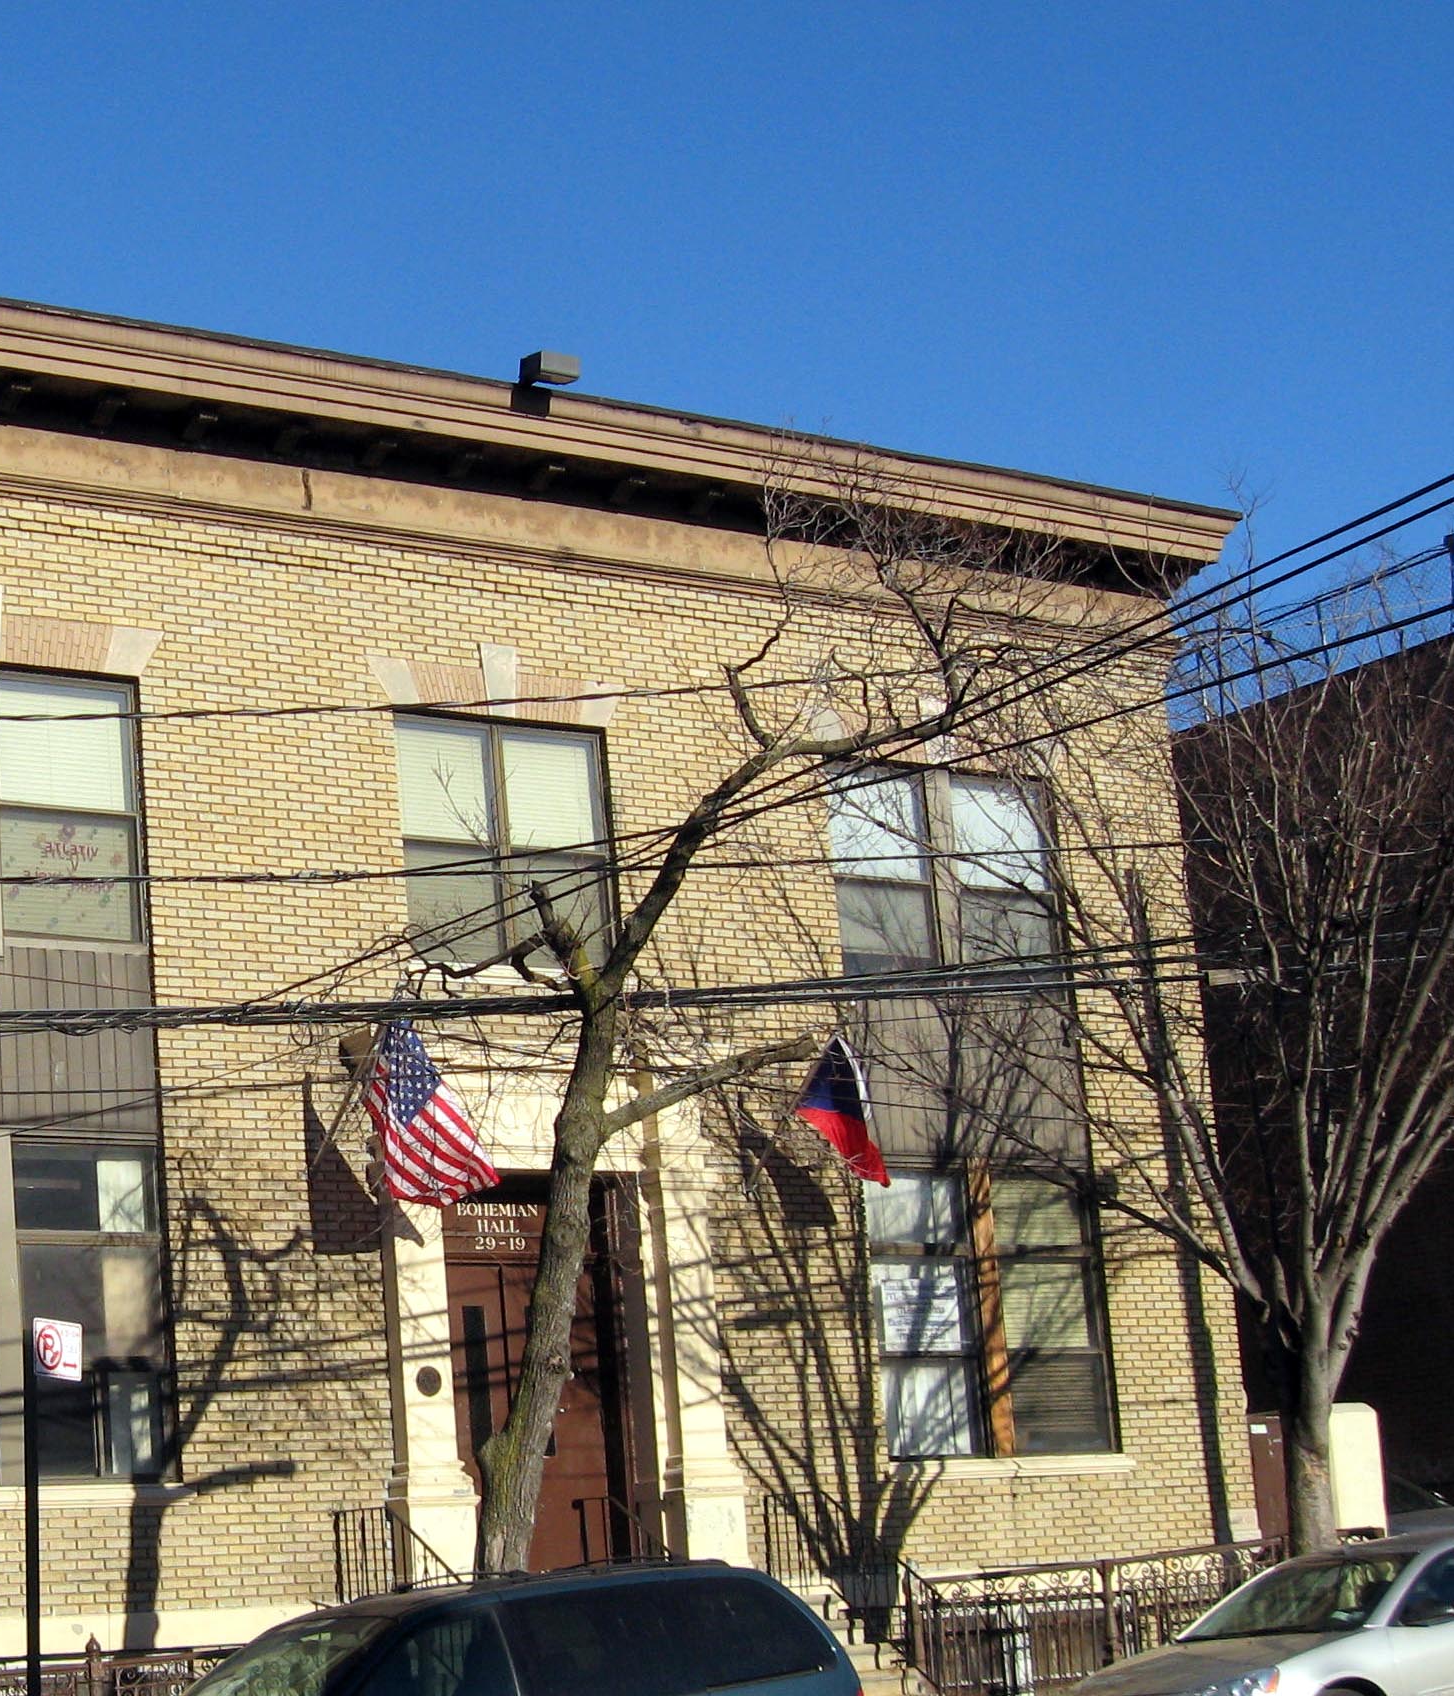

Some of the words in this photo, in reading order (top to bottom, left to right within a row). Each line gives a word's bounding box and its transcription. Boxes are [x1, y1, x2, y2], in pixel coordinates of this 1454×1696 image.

[456, 1202, 538, 1217] BOHEMIAN
[477, 1219, 520, 1233] HALL
[475, 1236, 526, 1251] 29-19
